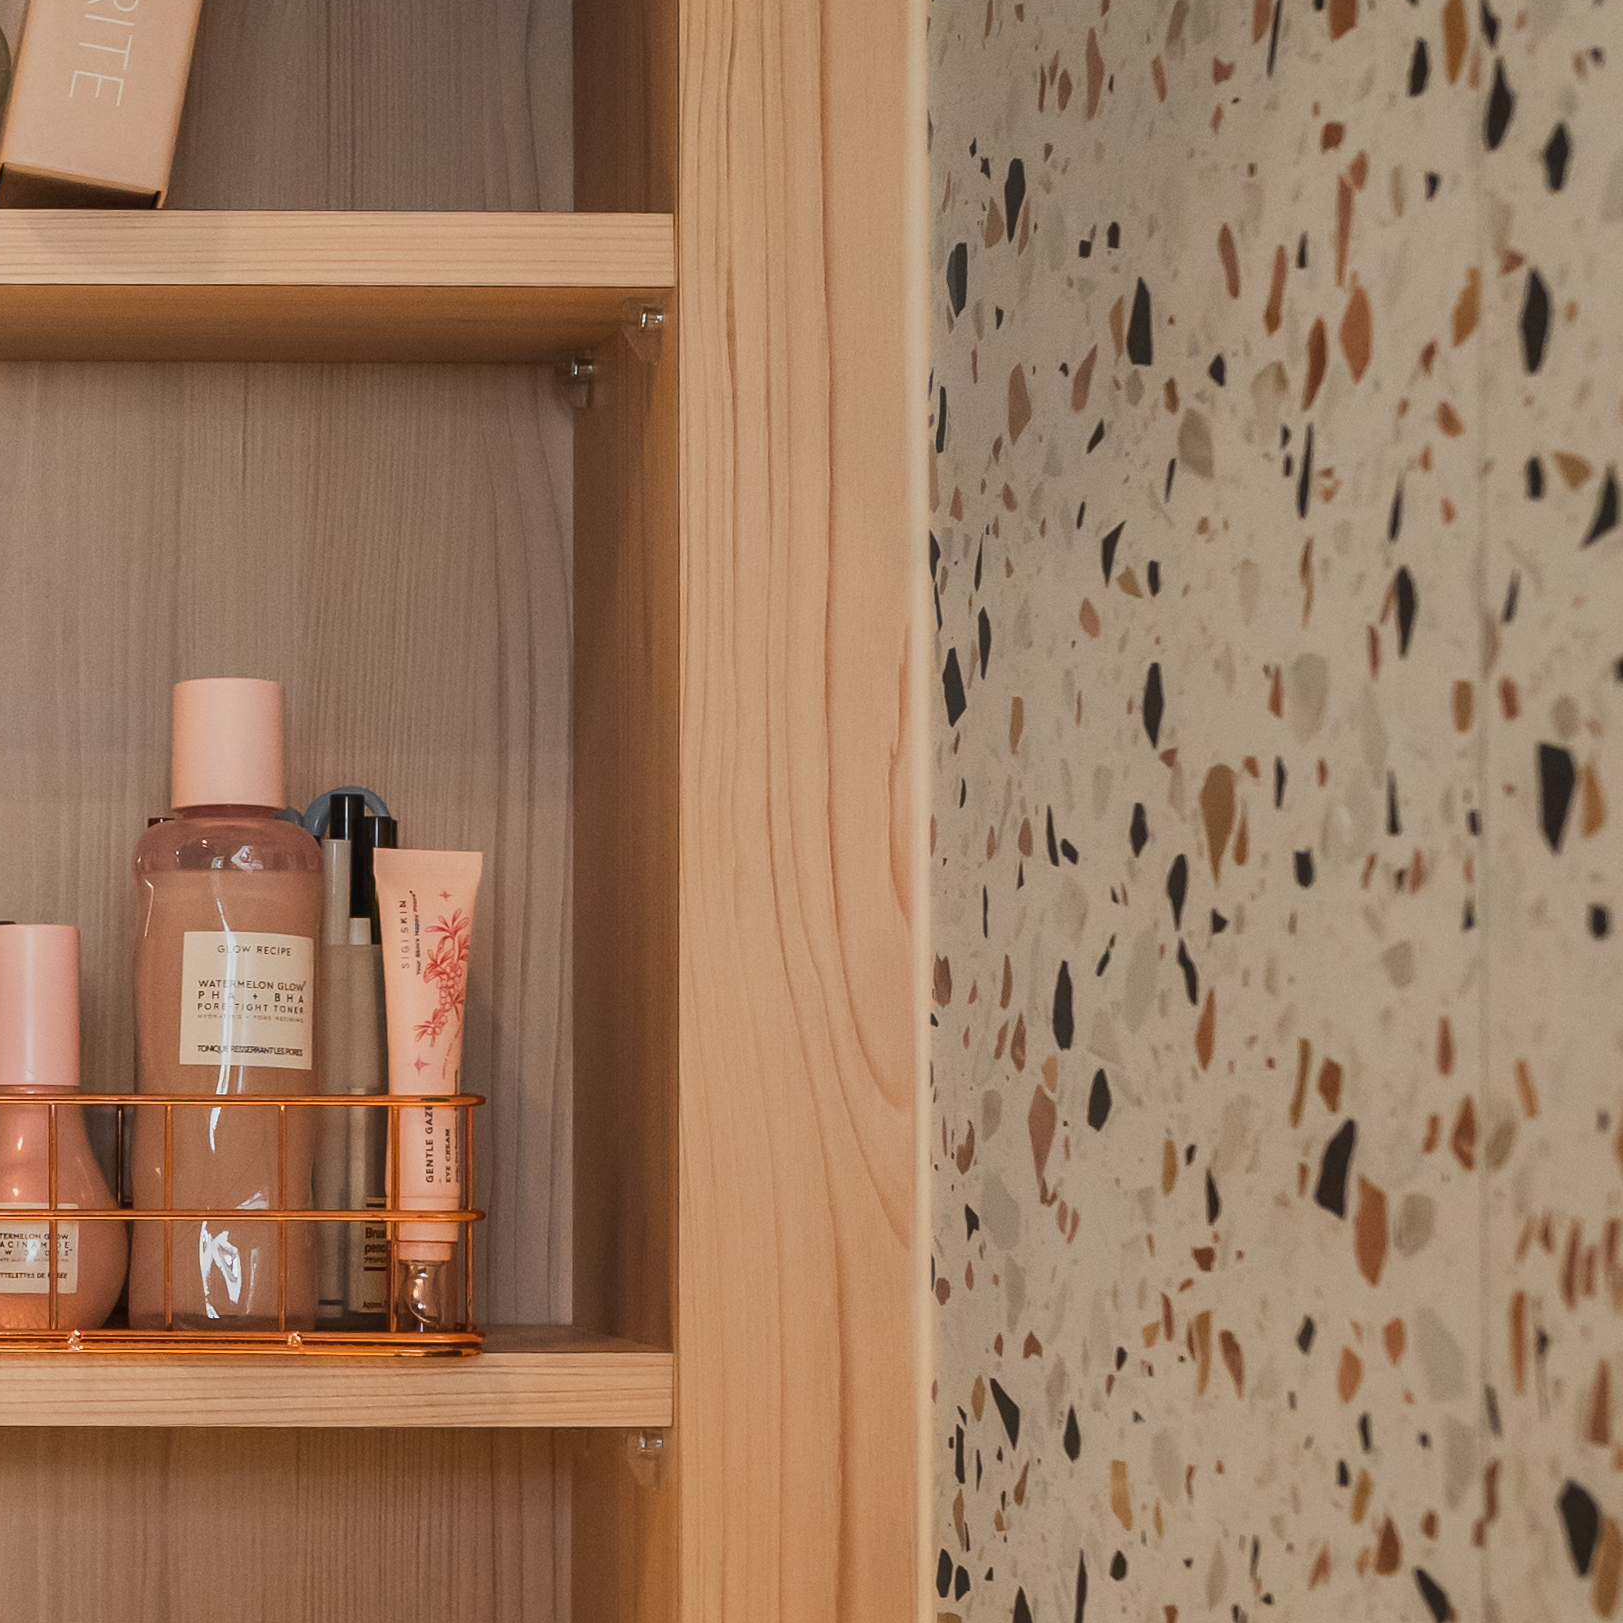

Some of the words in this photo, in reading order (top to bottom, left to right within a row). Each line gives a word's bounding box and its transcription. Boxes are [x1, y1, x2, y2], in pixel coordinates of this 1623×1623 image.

[217, 945, 251, 953] GLOW
[256, 946, 291, 956] RECIPE
[198, 980, 274, 989] WATERMELON
[274, 1005, 304, 1014] TONER
[197, 1045, 229, 1054] TONIQUE
[231, 1046, 273, 1054] RESSERRANT
[425, 1139, 434, 1183] GENTLE
